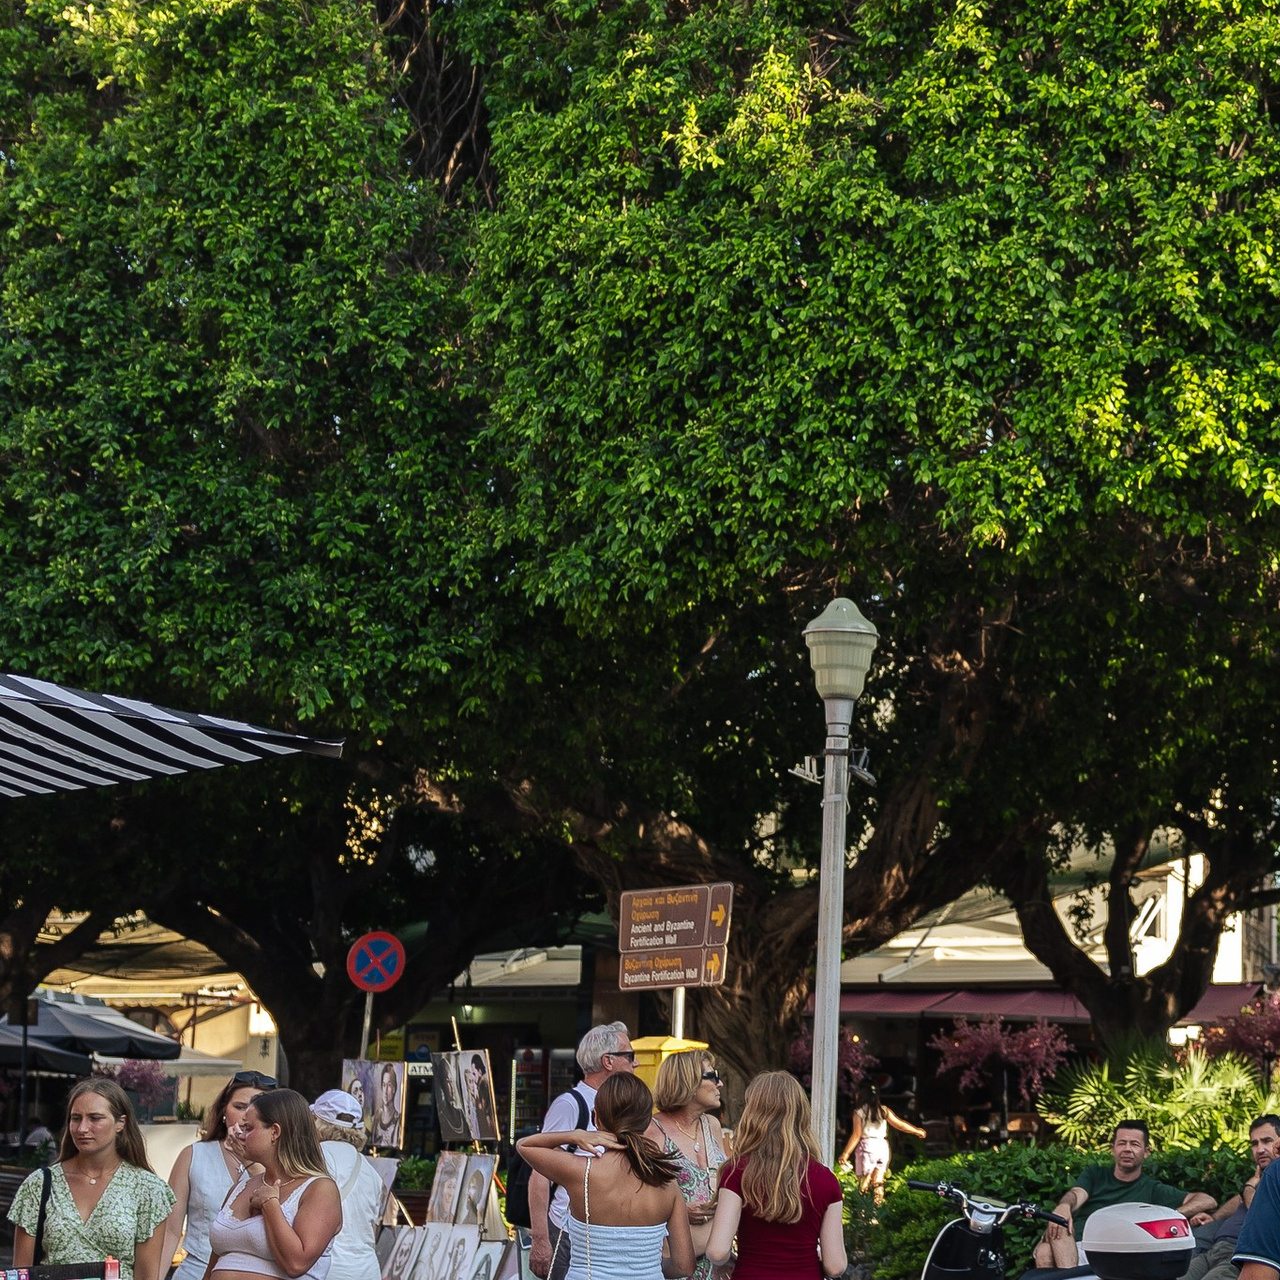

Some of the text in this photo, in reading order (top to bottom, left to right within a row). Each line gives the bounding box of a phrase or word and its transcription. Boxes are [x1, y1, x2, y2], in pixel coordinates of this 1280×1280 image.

[631, 919, 695, 934] Ancient and Byzantine
[630, 934, 677, 948] Fortification Wall
[624, 968, 698, 985] Byzantine Fortification Wall
